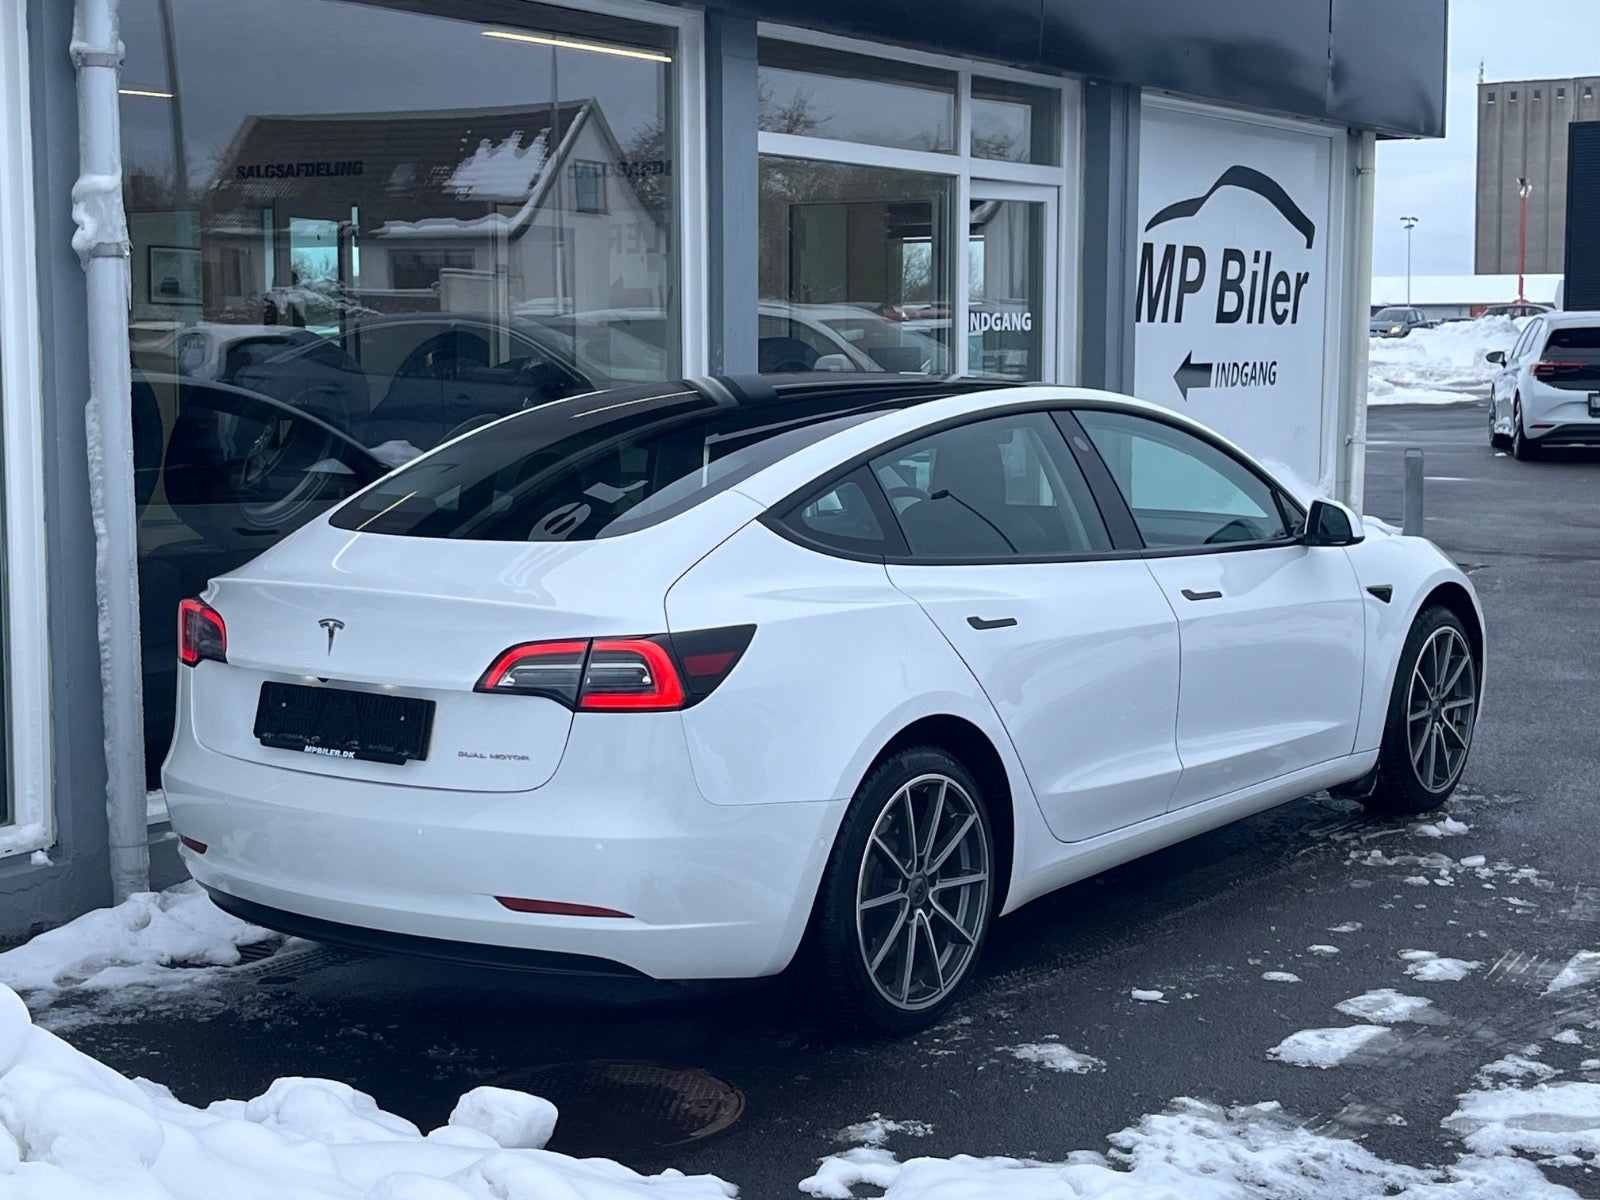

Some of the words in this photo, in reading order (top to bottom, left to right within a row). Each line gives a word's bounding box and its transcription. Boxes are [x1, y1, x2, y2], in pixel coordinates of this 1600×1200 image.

[236, 161, 364, 180] SALGSAFDELING
[1135, 242, 1206, 323] MP
[1215, 247, 1310, 325] Biler
[969, 312, 1032, 332] NDGANG
[1215, 361, 1277, 388] INDGANG
[304, 745, 356, 759] MPBILER.DK
[457, 750, 487, 759] DUAL
[489, 753, 530, 761] MOTOR
